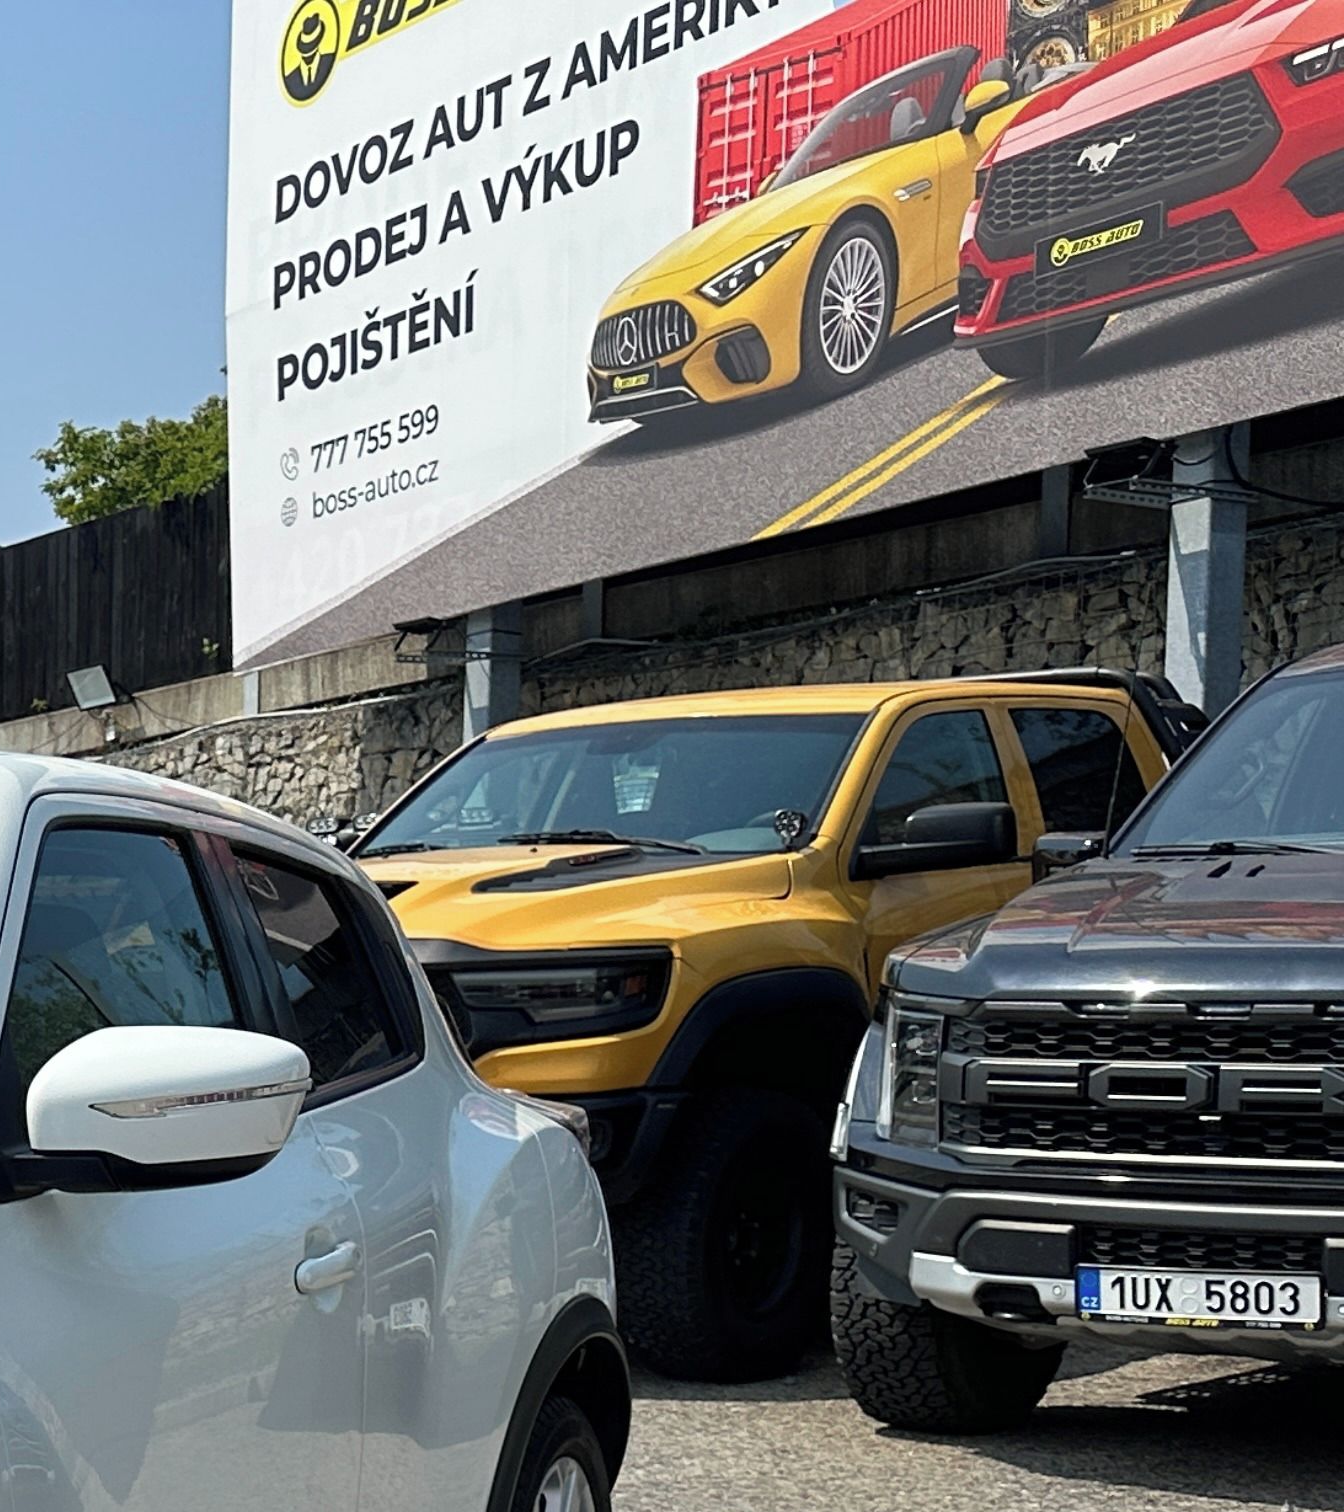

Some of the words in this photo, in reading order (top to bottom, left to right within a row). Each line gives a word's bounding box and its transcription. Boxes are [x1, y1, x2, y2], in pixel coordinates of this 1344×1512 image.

[275, 120, 413, 224] DOVOZ
[423, 75, 511, 158] AUT
[523, 57, 552, 116] Z
[273, 204, 428, 309] PRODEJ
[438, 191, 470, 244] A
[481, 119, 639, 224] VÝKUP
[276, 269, 479, 402] POJIŠTĚNÍ
[310, 433, 349, 474] 777
[355, 421, 393, 460] 755
[398, 404, 439, 446] 599
[311, 457, 440, 520] boss-auto.cz
[1081, 1296, 1099, 1308] CZ
[1111, 1276, 1174, 1312] 1UX
[1205, 1280, 1300, 1316] 5803
